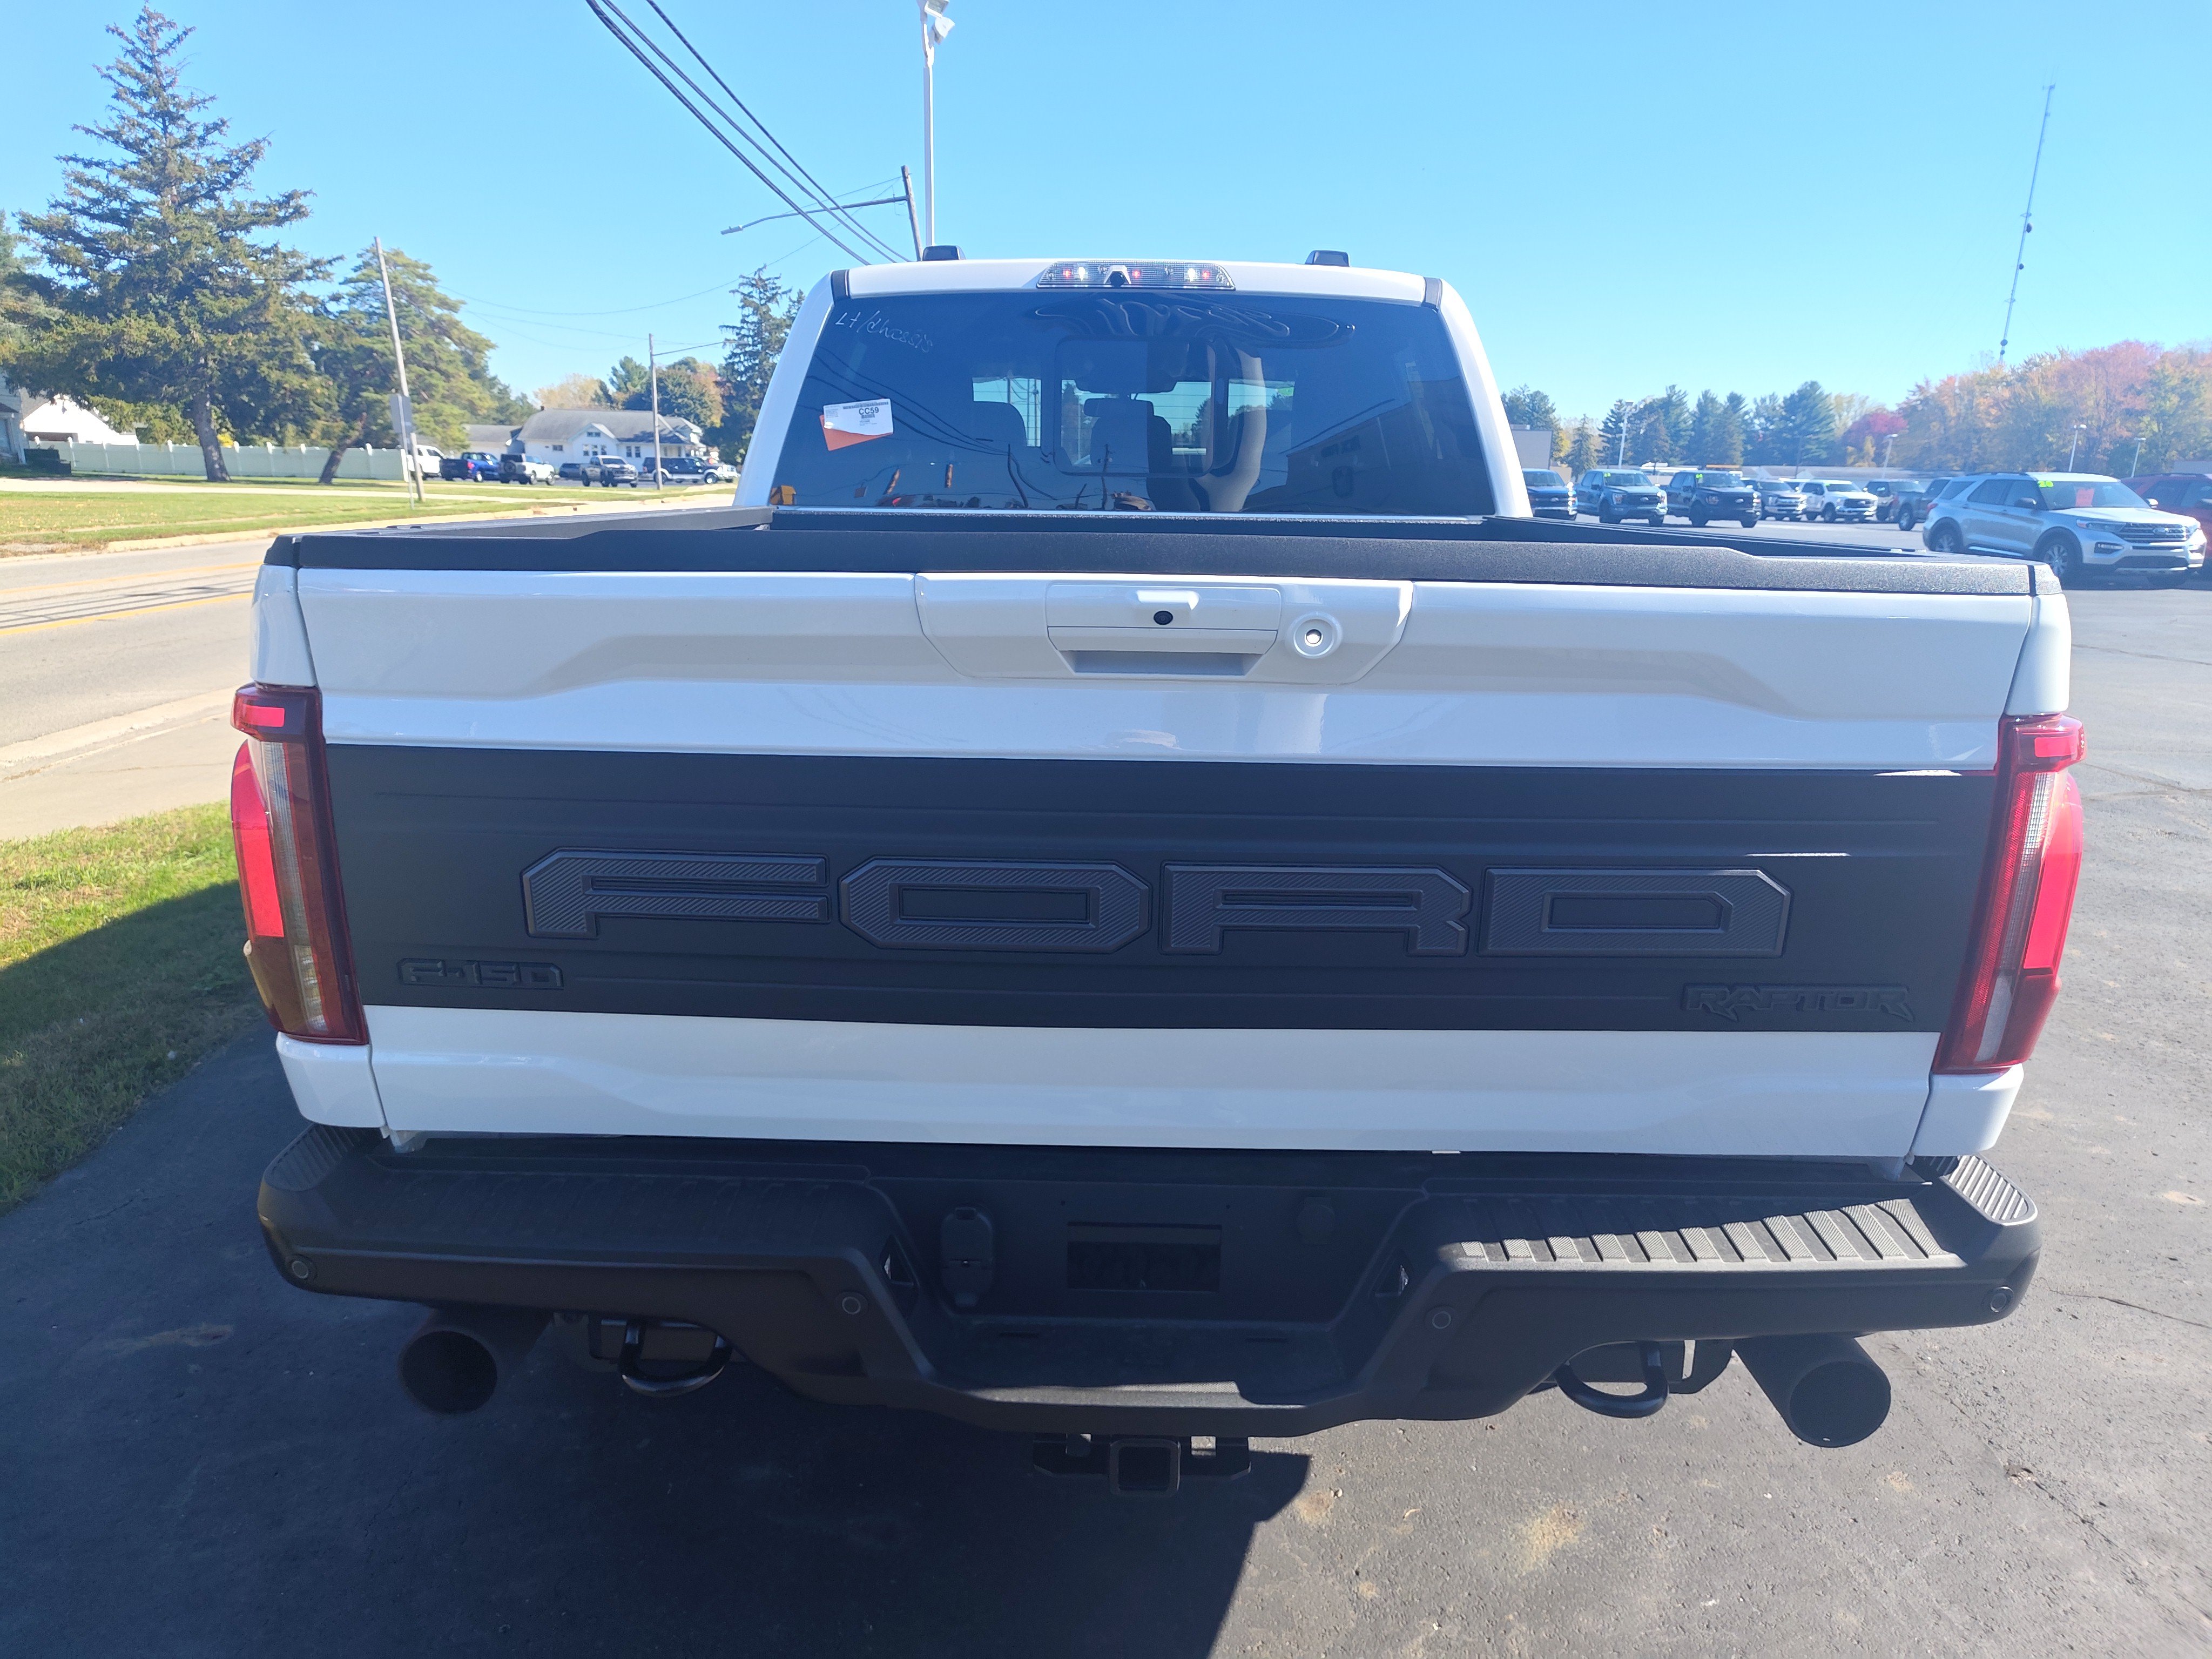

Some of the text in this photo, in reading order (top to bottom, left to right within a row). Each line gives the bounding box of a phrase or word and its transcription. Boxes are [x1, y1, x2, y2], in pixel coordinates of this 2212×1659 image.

[858, 407, 879, 415] CC59
[522, 847, 1792, 958] FORD
[397, 958, 564, 990] F-150
[1681, 983, 1915, 1023] RAPTOR
